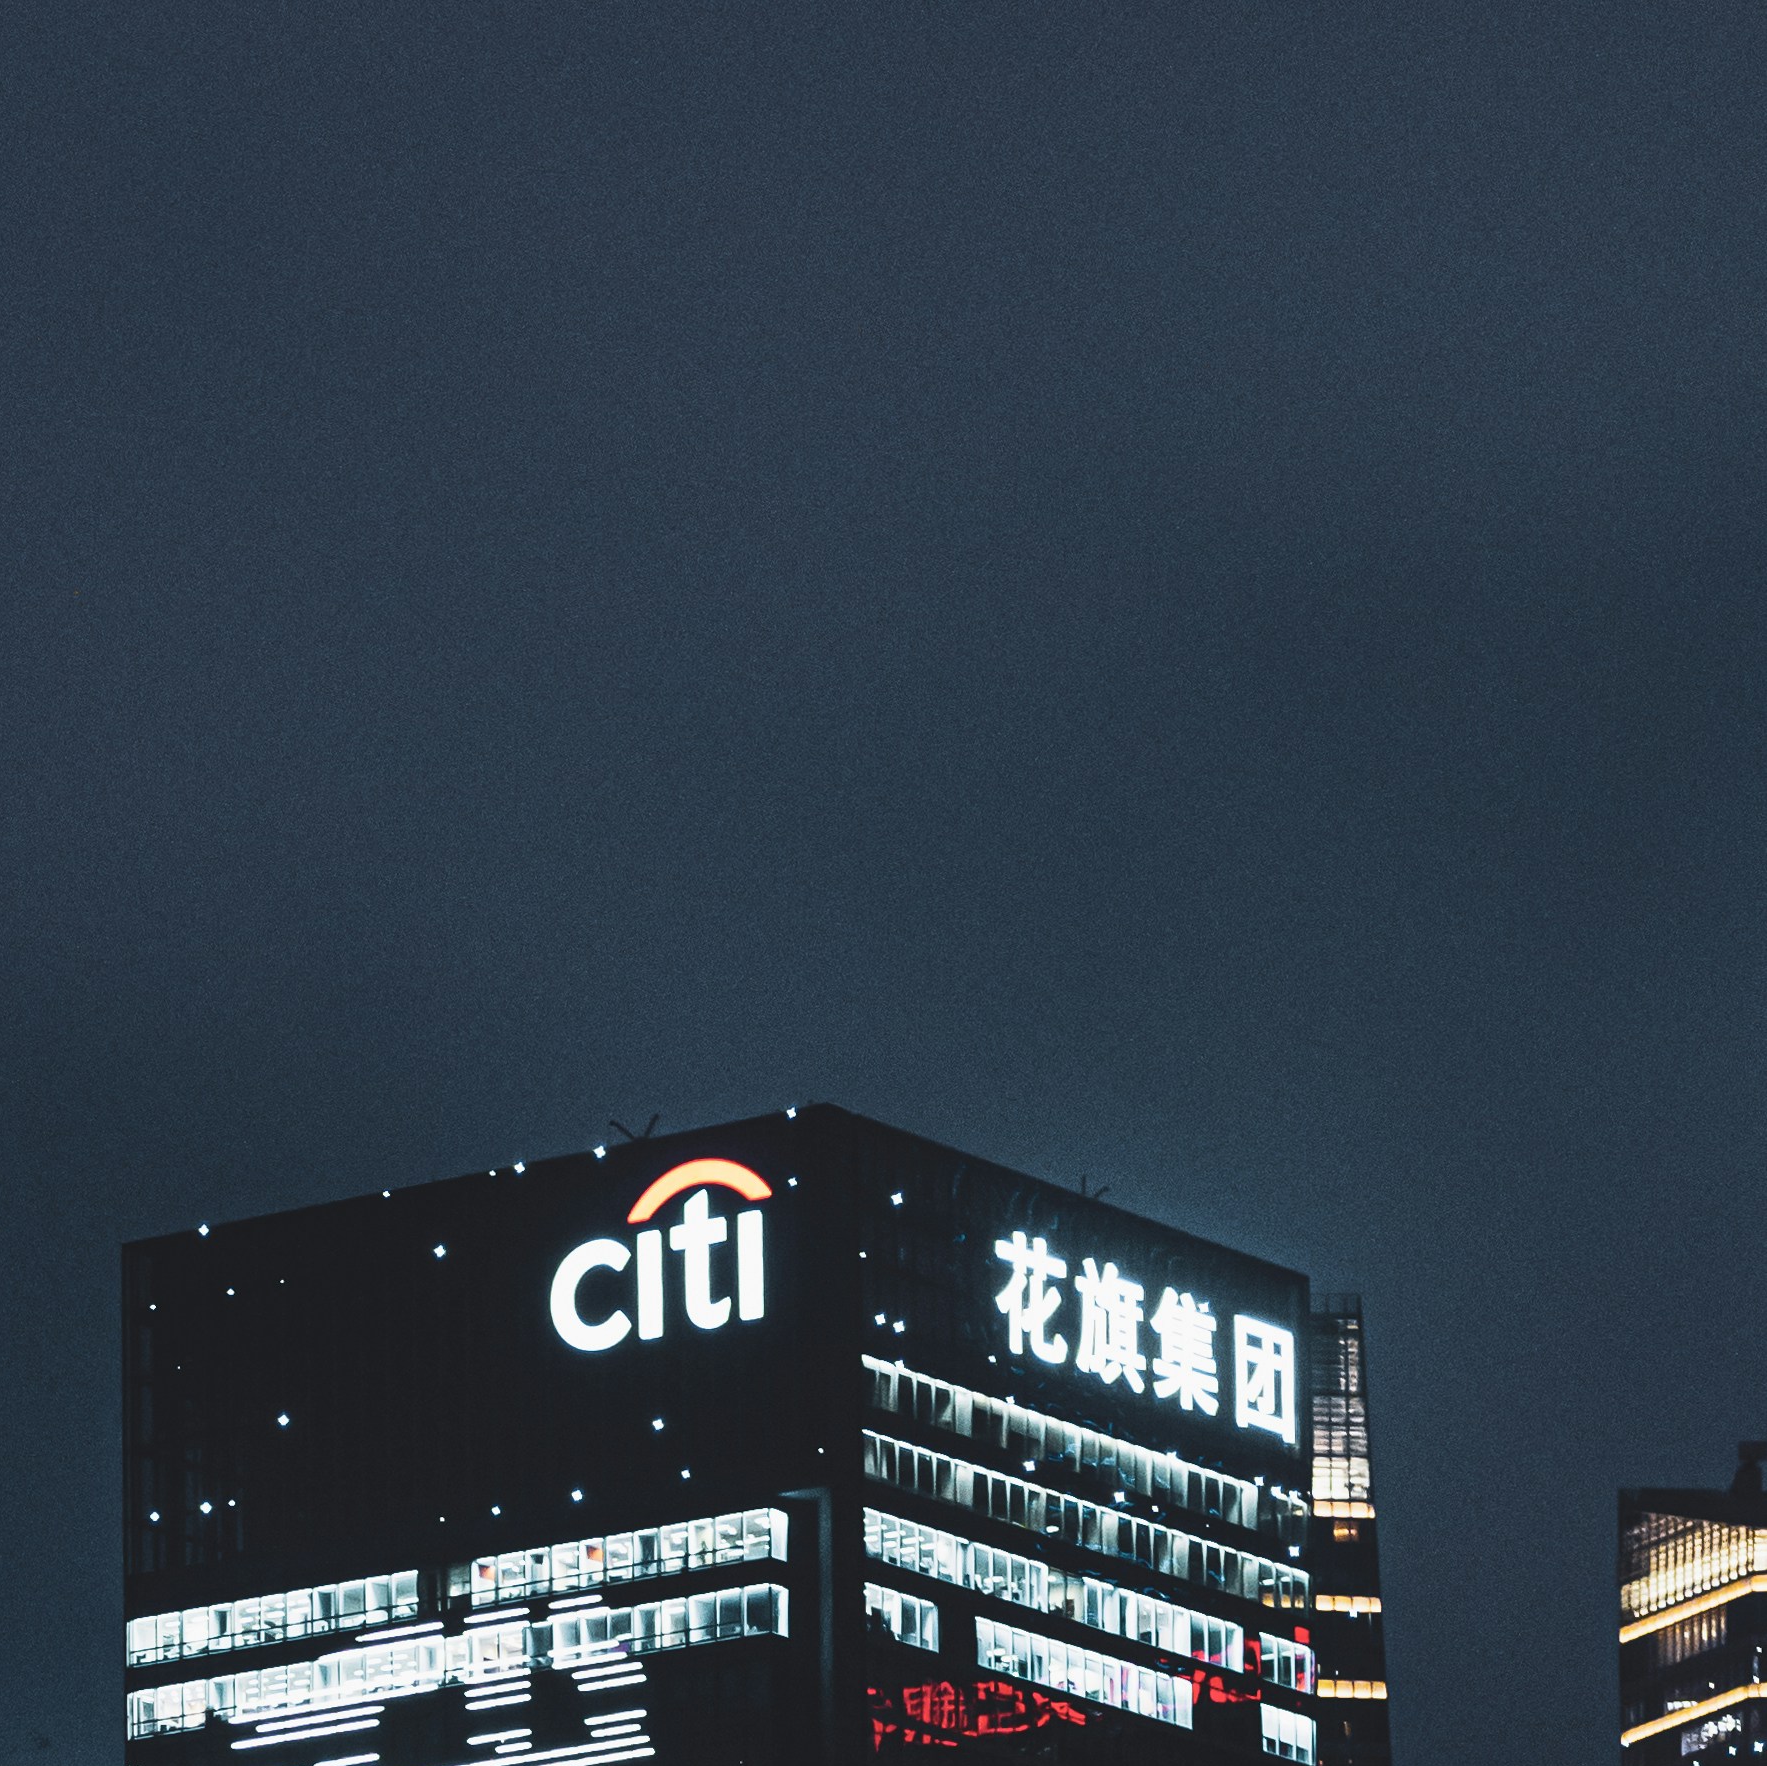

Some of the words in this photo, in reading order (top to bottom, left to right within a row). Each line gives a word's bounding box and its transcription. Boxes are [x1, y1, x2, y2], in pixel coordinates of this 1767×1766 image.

[549, 1188, 765, 1352] citi
[993, 1230, 1297, 1445] 花旗集团
